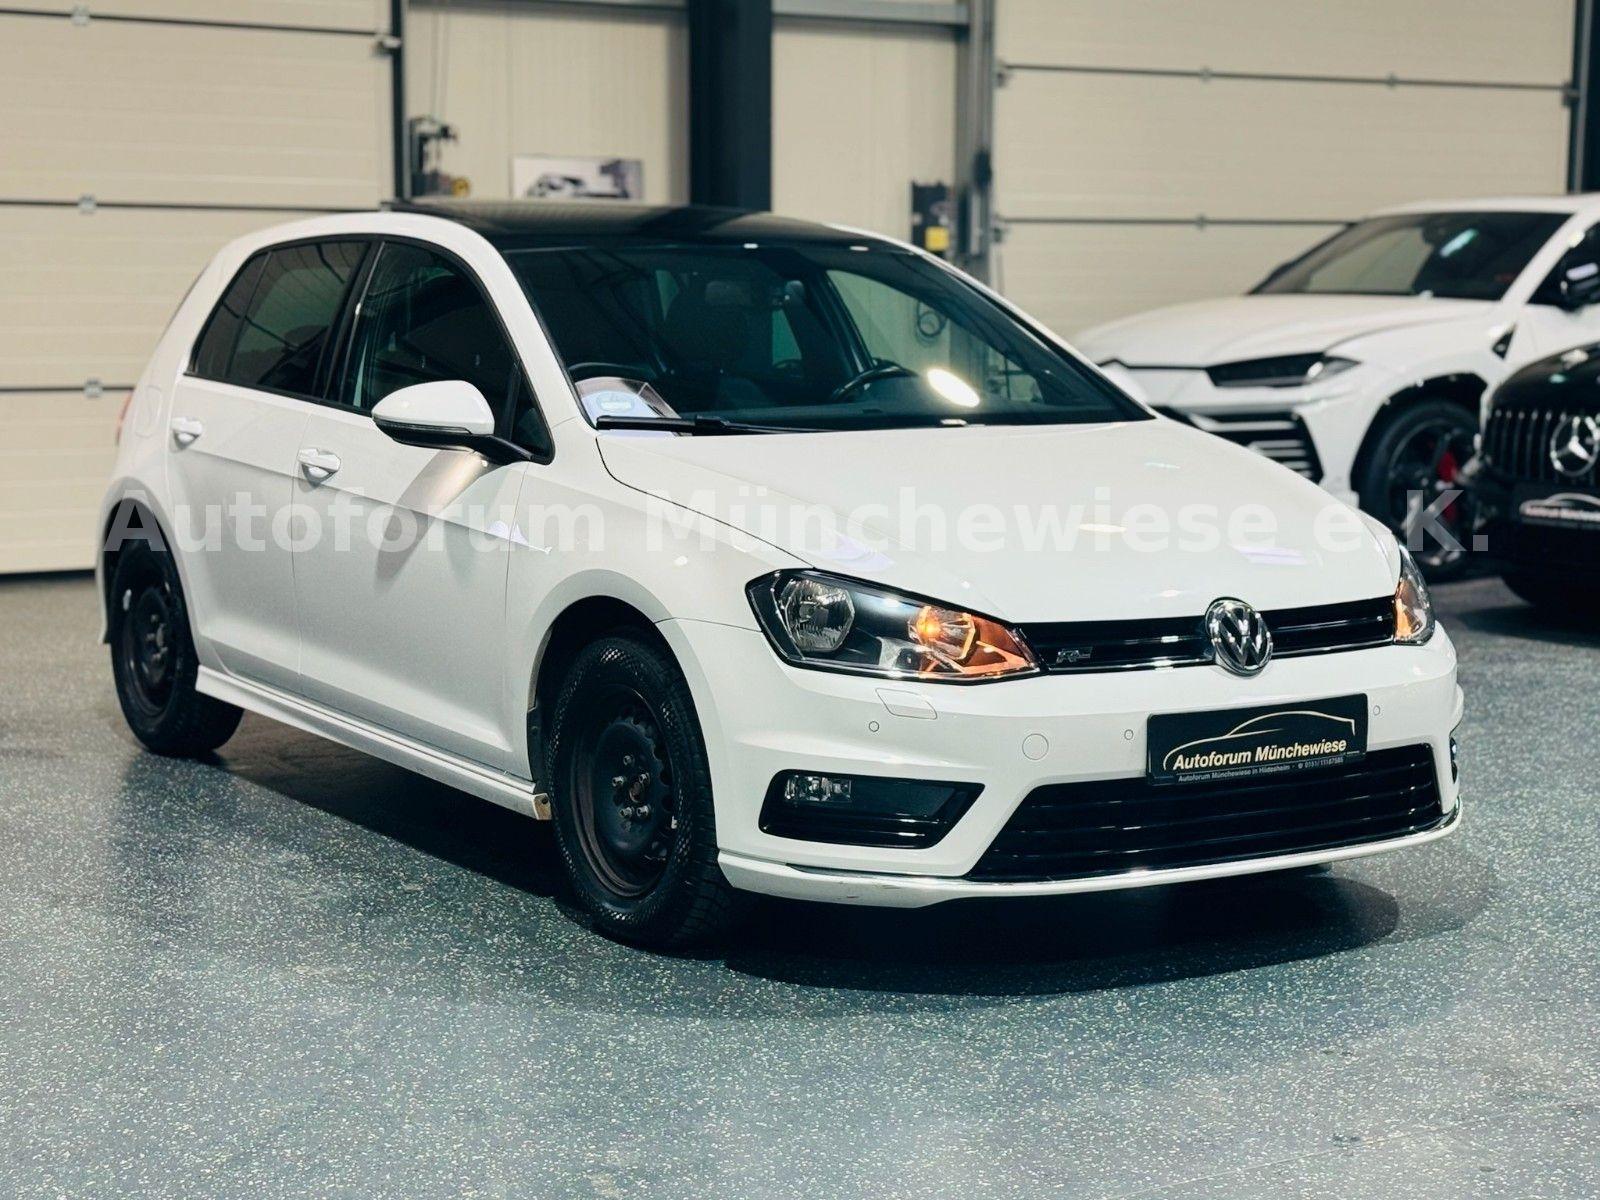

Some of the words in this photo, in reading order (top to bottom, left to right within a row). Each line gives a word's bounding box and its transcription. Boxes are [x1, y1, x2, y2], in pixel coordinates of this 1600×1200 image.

[1173, 750, 1251, 770] Autoforum
[1255, 739, 1347, 762] Münchewiese
[1178, 773, 1211, 782] Autoforum
